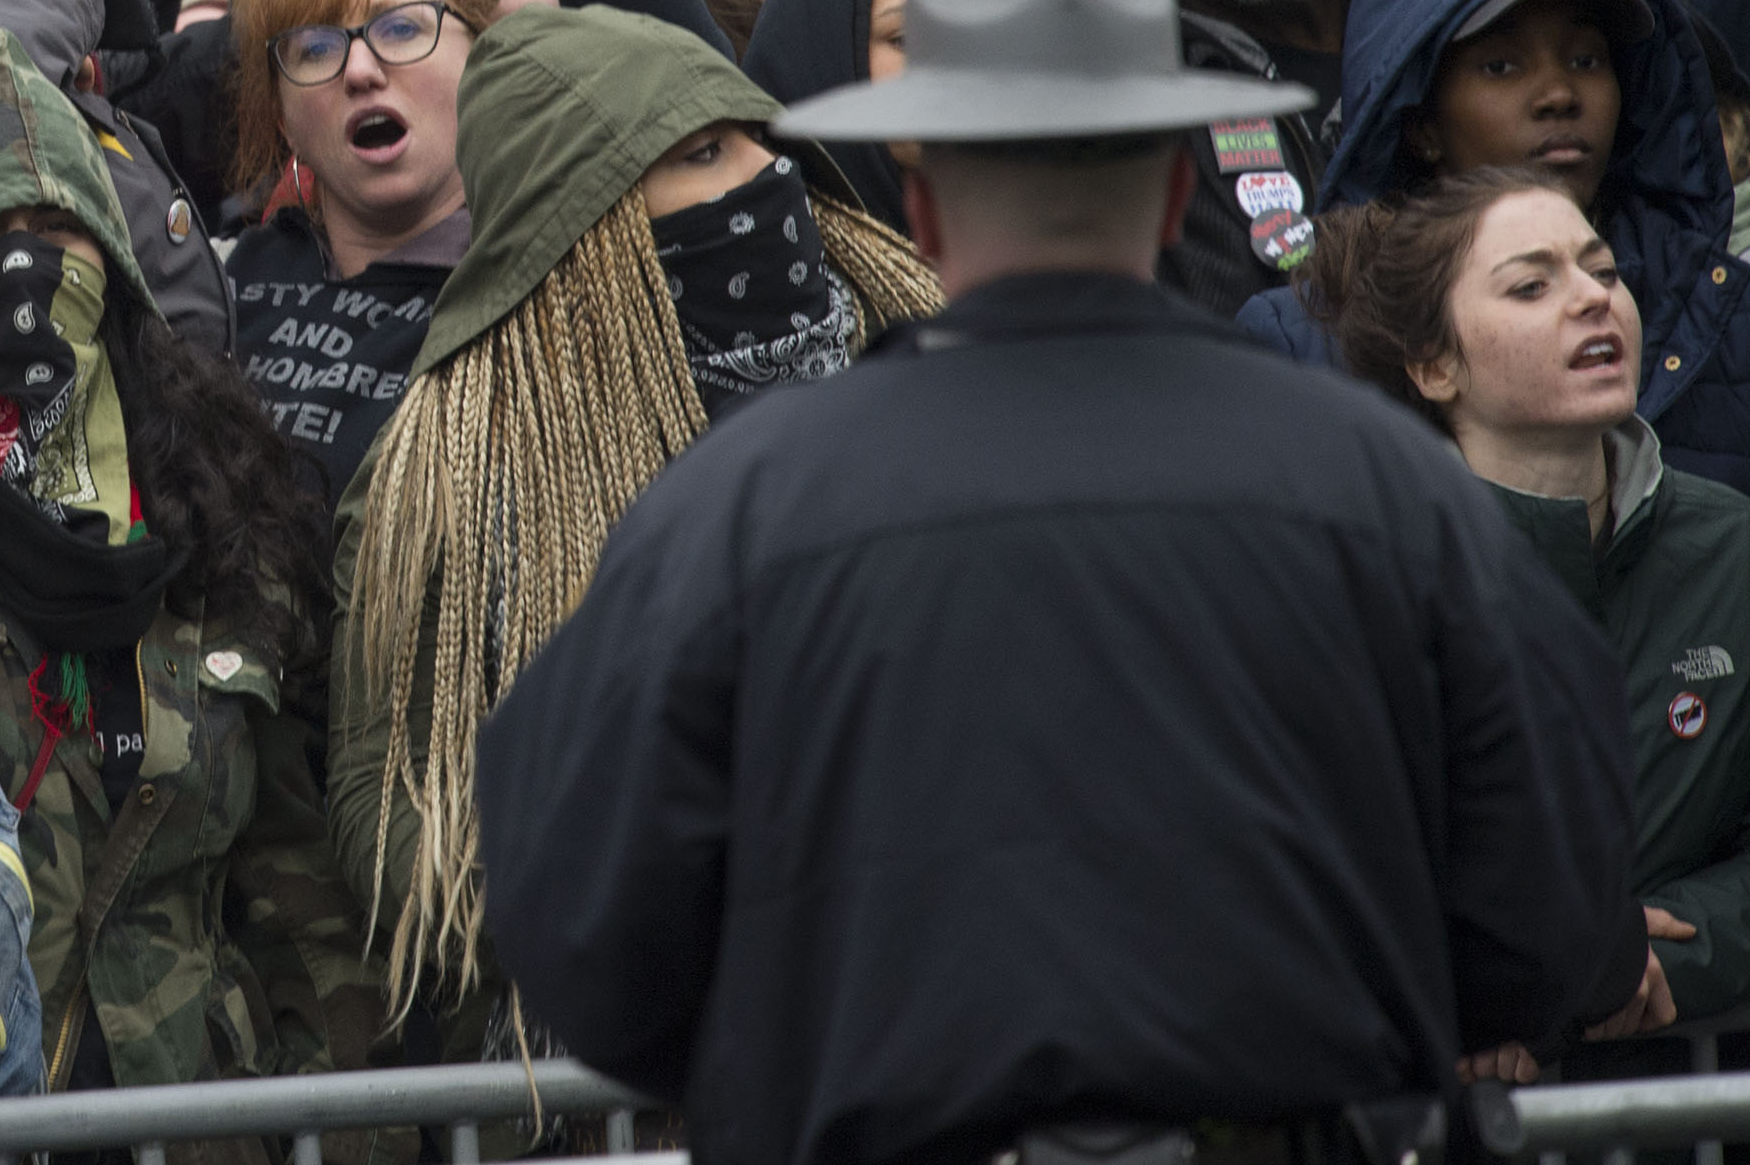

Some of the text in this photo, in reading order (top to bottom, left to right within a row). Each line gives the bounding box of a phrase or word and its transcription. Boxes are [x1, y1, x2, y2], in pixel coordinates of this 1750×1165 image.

[268, 316, 353, 359] AND
[259, 398, 343, 445] TE!
[116, 731, 147, 759] pa
